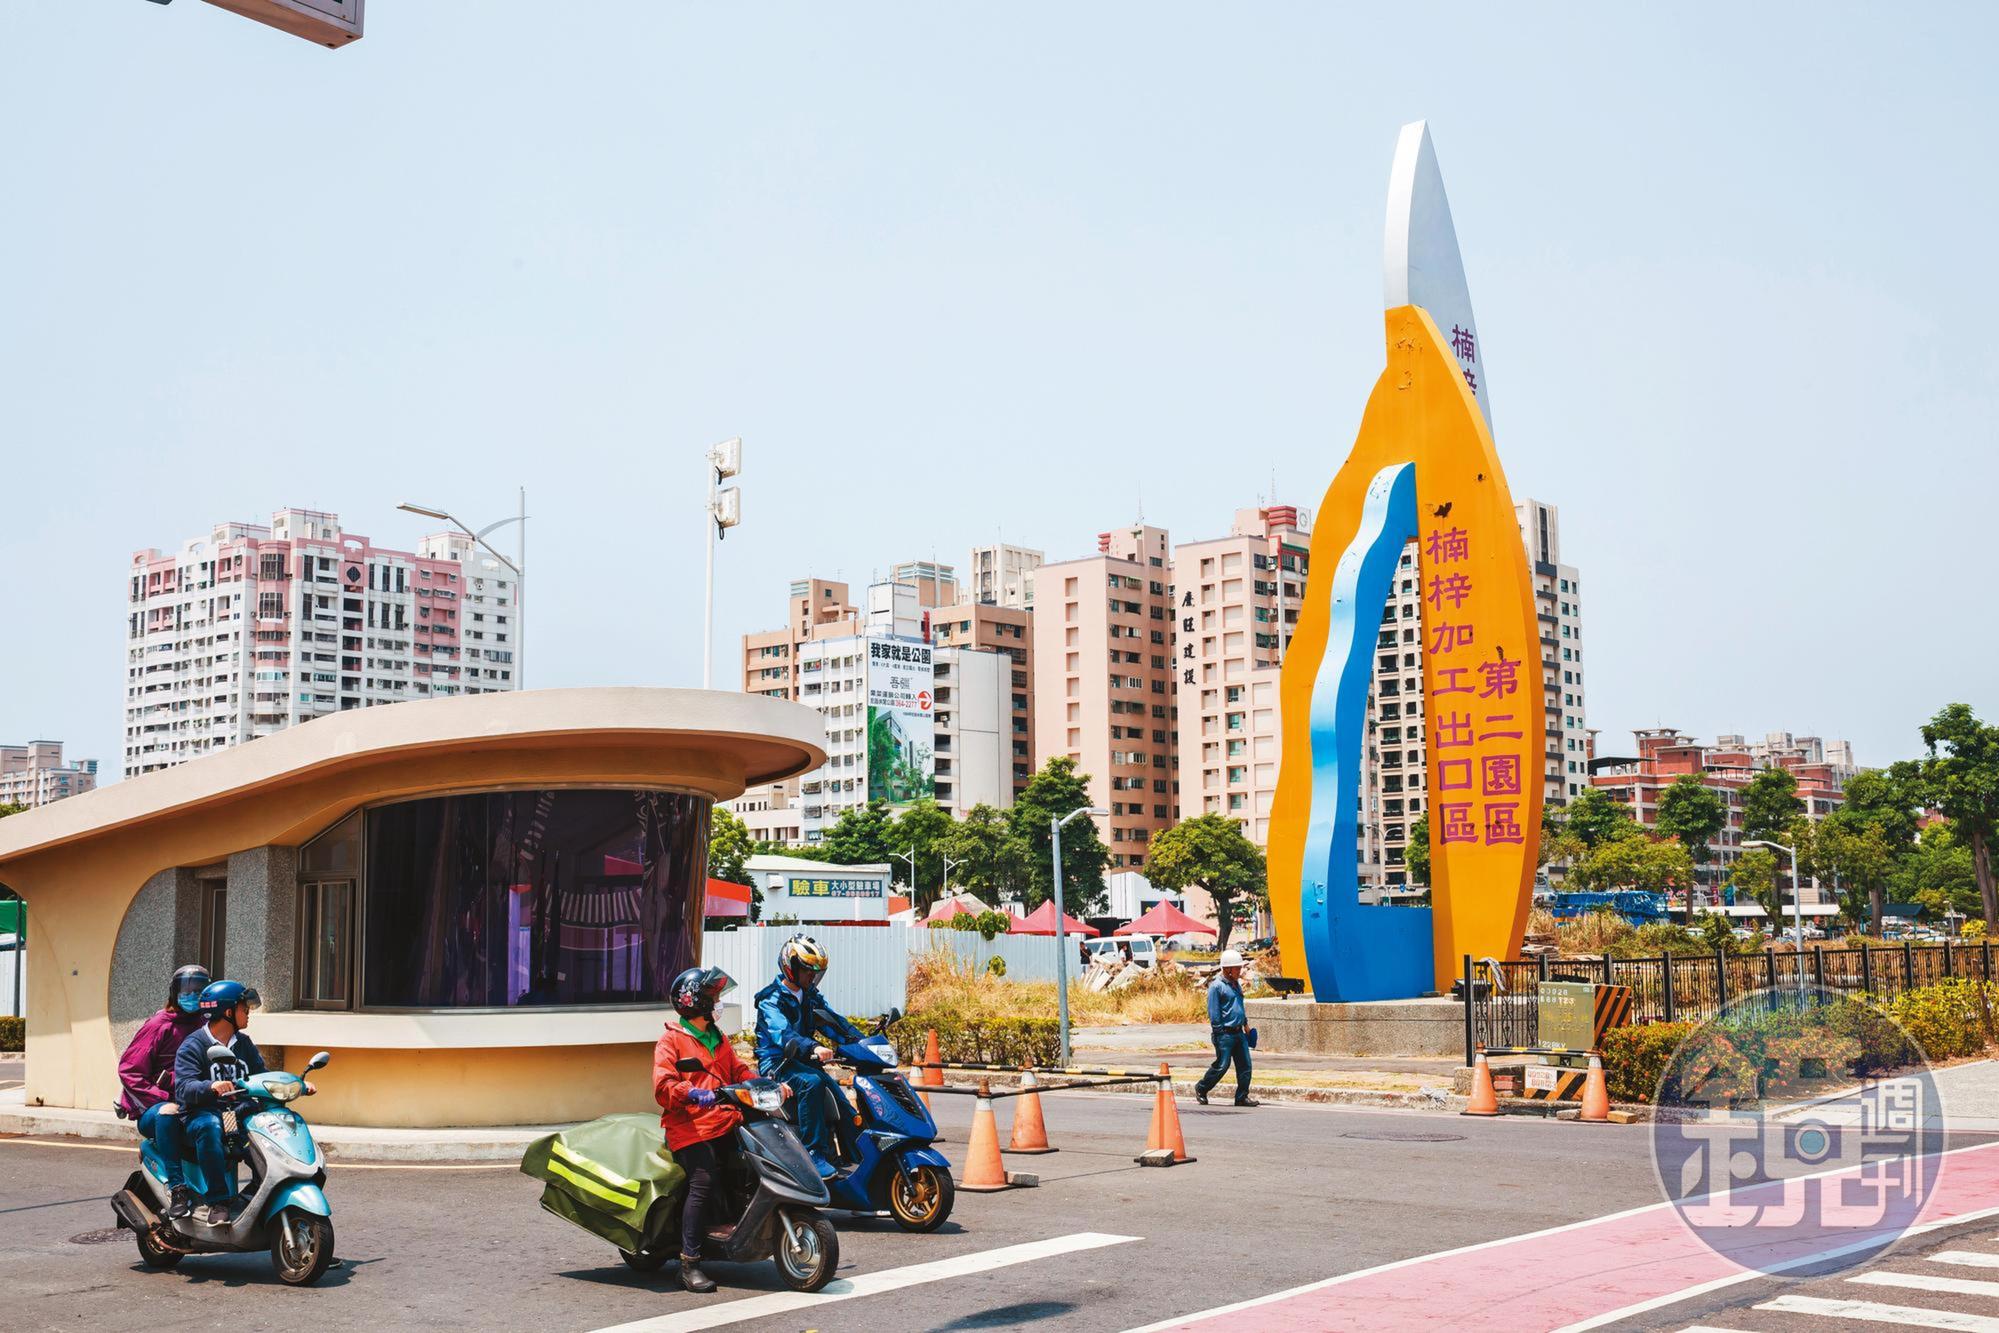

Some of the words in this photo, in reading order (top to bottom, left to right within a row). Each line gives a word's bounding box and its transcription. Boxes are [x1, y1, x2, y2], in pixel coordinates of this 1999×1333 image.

[870, 642, 931, 665] 我家就是公園
[1426, 526, 1478, 846] 楠梓加工出口區
[1477, 658, 1524, 846] 第二園區
[791, 879, 829, 896] 驗車
